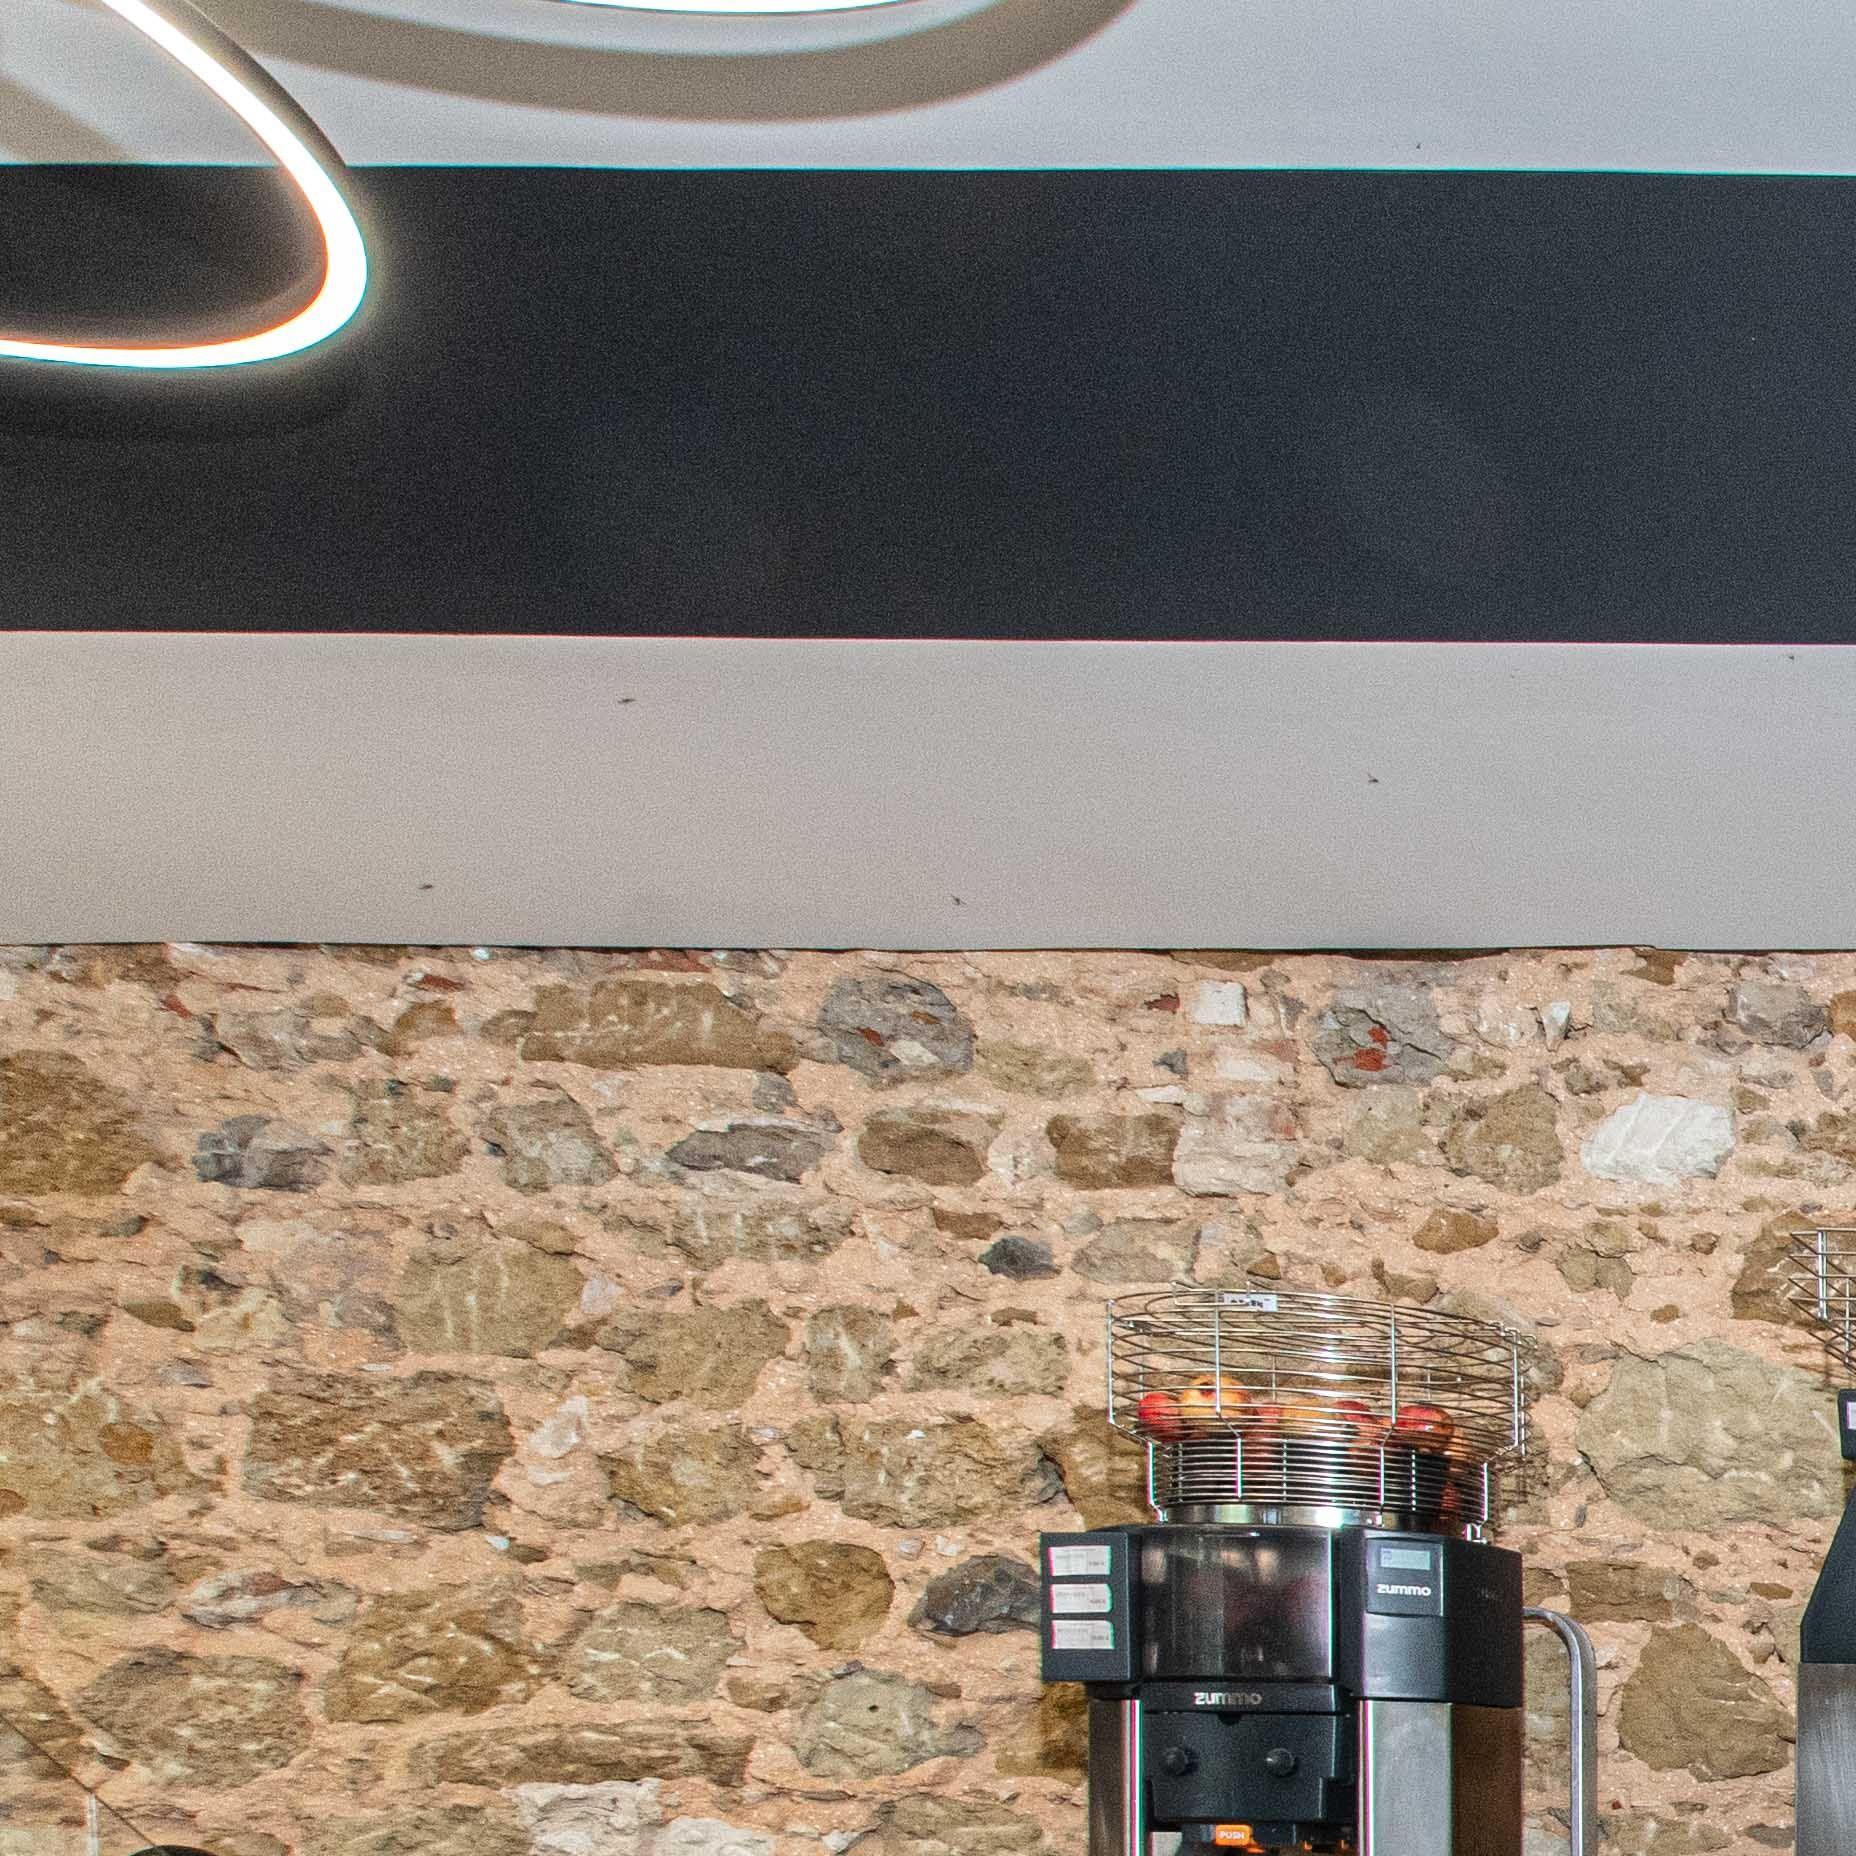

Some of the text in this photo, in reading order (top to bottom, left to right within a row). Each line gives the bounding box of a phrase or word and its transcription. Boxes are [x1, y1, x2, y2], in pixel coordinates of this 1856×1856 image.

[1376, 1583, 1432, 1597] zummo
[1194, 1692, 1263, 1705] zummo
[1218, 1830, 1245, 1840] PUSH
